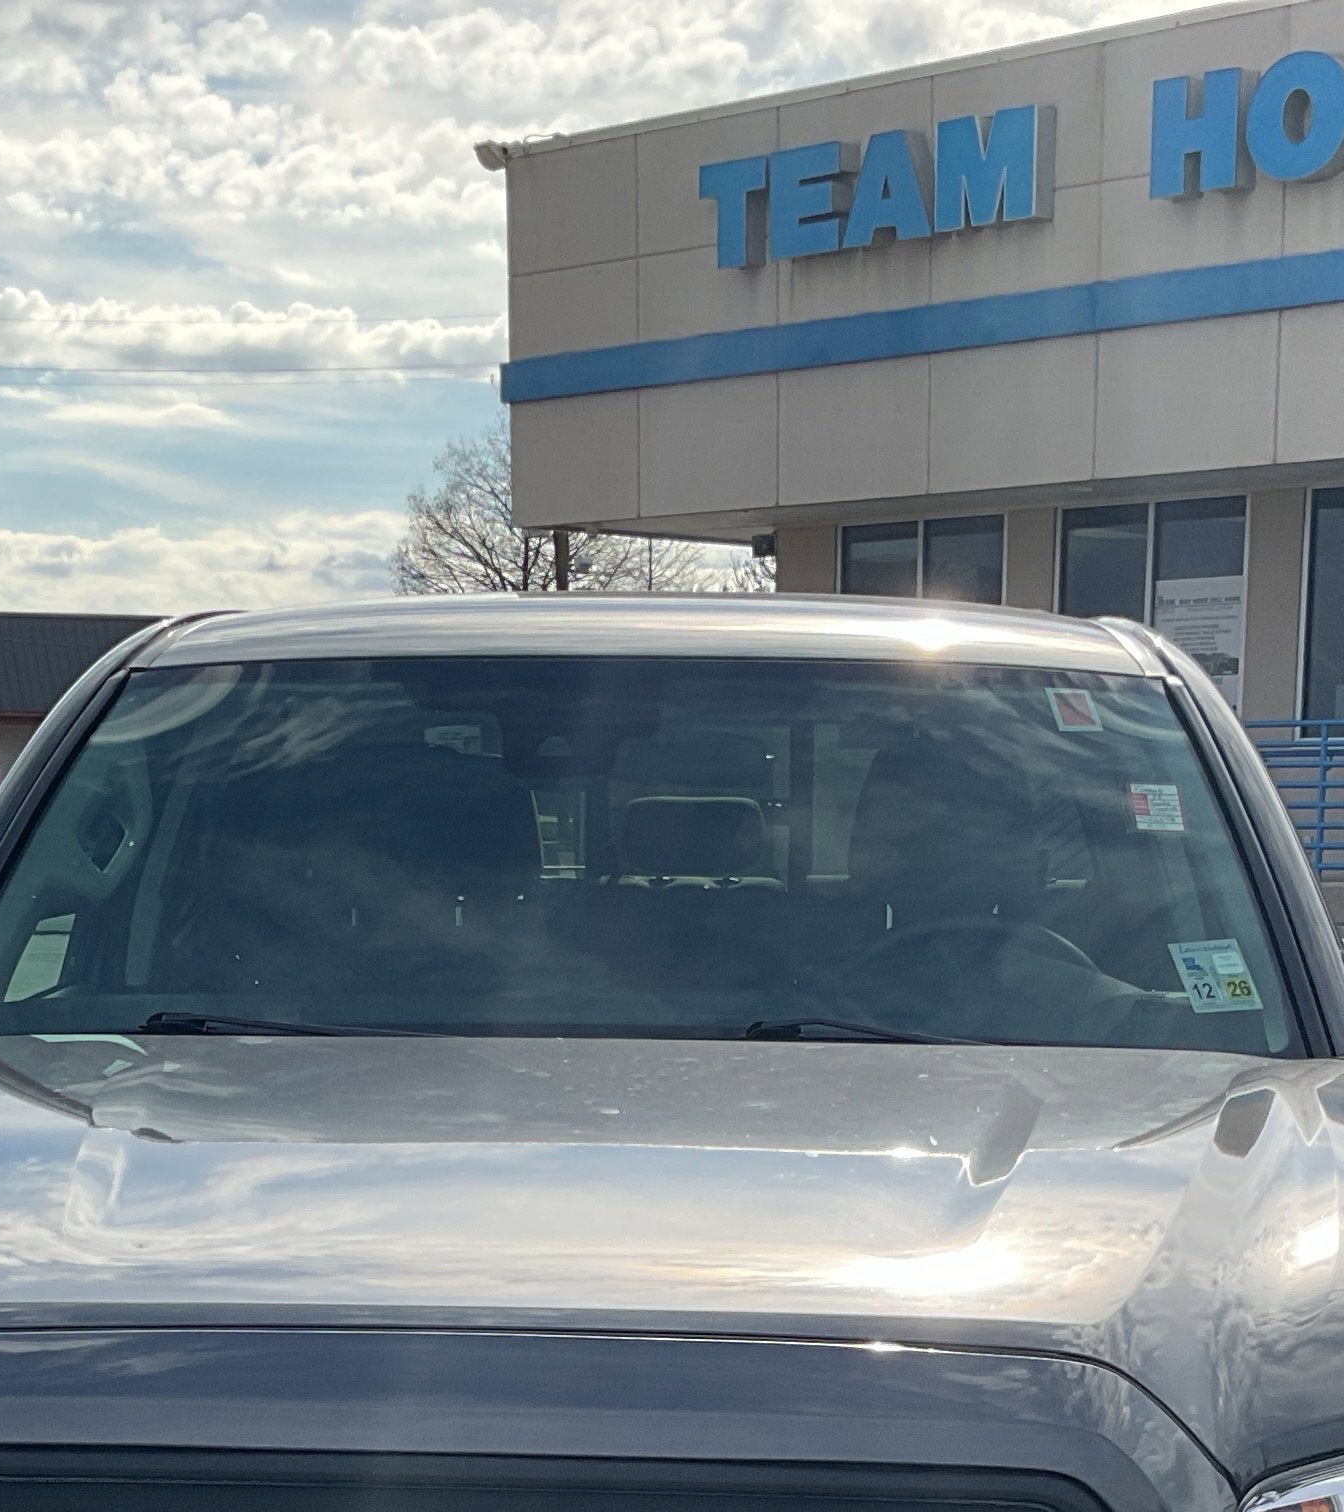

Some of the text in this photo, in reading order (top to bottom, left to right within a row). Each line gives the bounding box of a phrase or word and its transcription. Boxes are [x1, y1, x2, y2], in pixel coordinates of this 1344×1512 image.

[698, 104, 1051, 271] TEAM
[1192, 980, 1252, 999] 12 26
